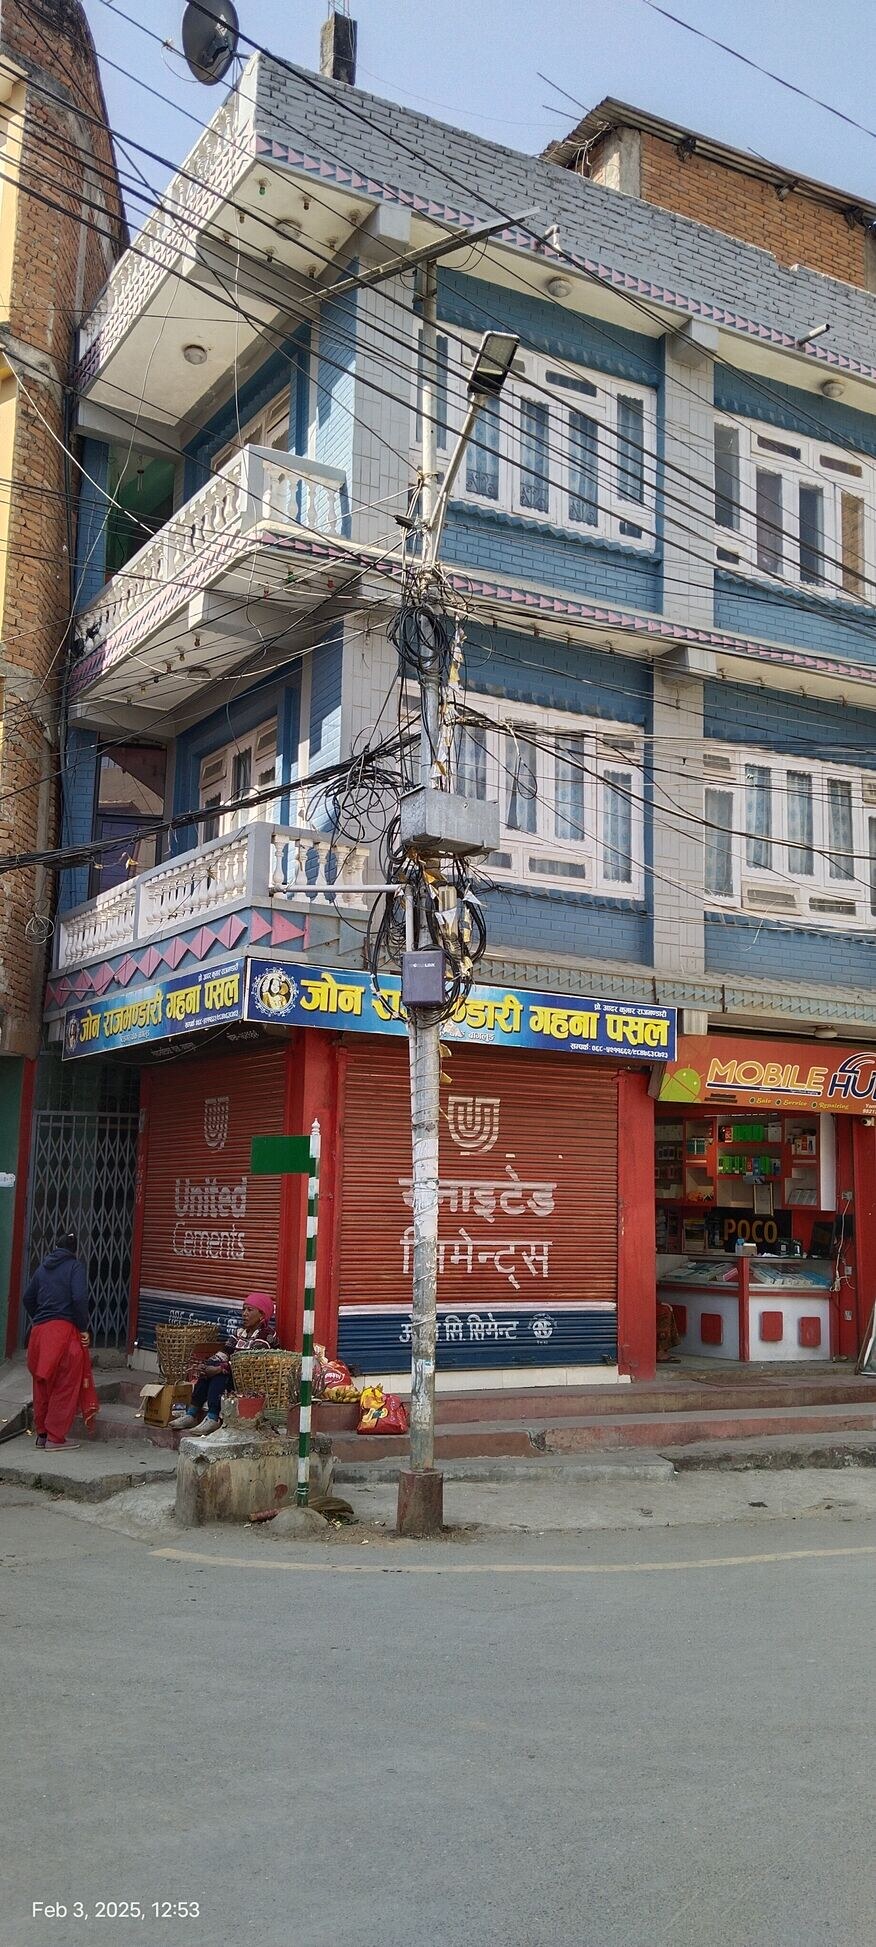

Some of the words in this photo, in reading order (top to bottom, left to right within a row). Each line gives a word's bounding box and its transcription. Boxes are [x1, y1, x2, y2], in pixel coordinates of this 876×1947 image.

[80, 1009, 101, 1042] जोन
[166, 985, 202, 1020] गहना
[204, 973, 240, 1010] पसल
[299, 972, 366, 1015] जोन
[529, 1005, 600, 1039] गहना
[605, 1013, 670, 1047] पसल
[707, 1058, 828, 1091] MOBILE
[827, 1072, 876, 1101] HU
[783, 1099, 808, 1107] Service
[819, 1102, 849, 1110] Repairing
[175, 1177, 247, 1218] United
[173, 1221, 246, 1260] Cements
[724, 1218, 778, 1244] POCO
